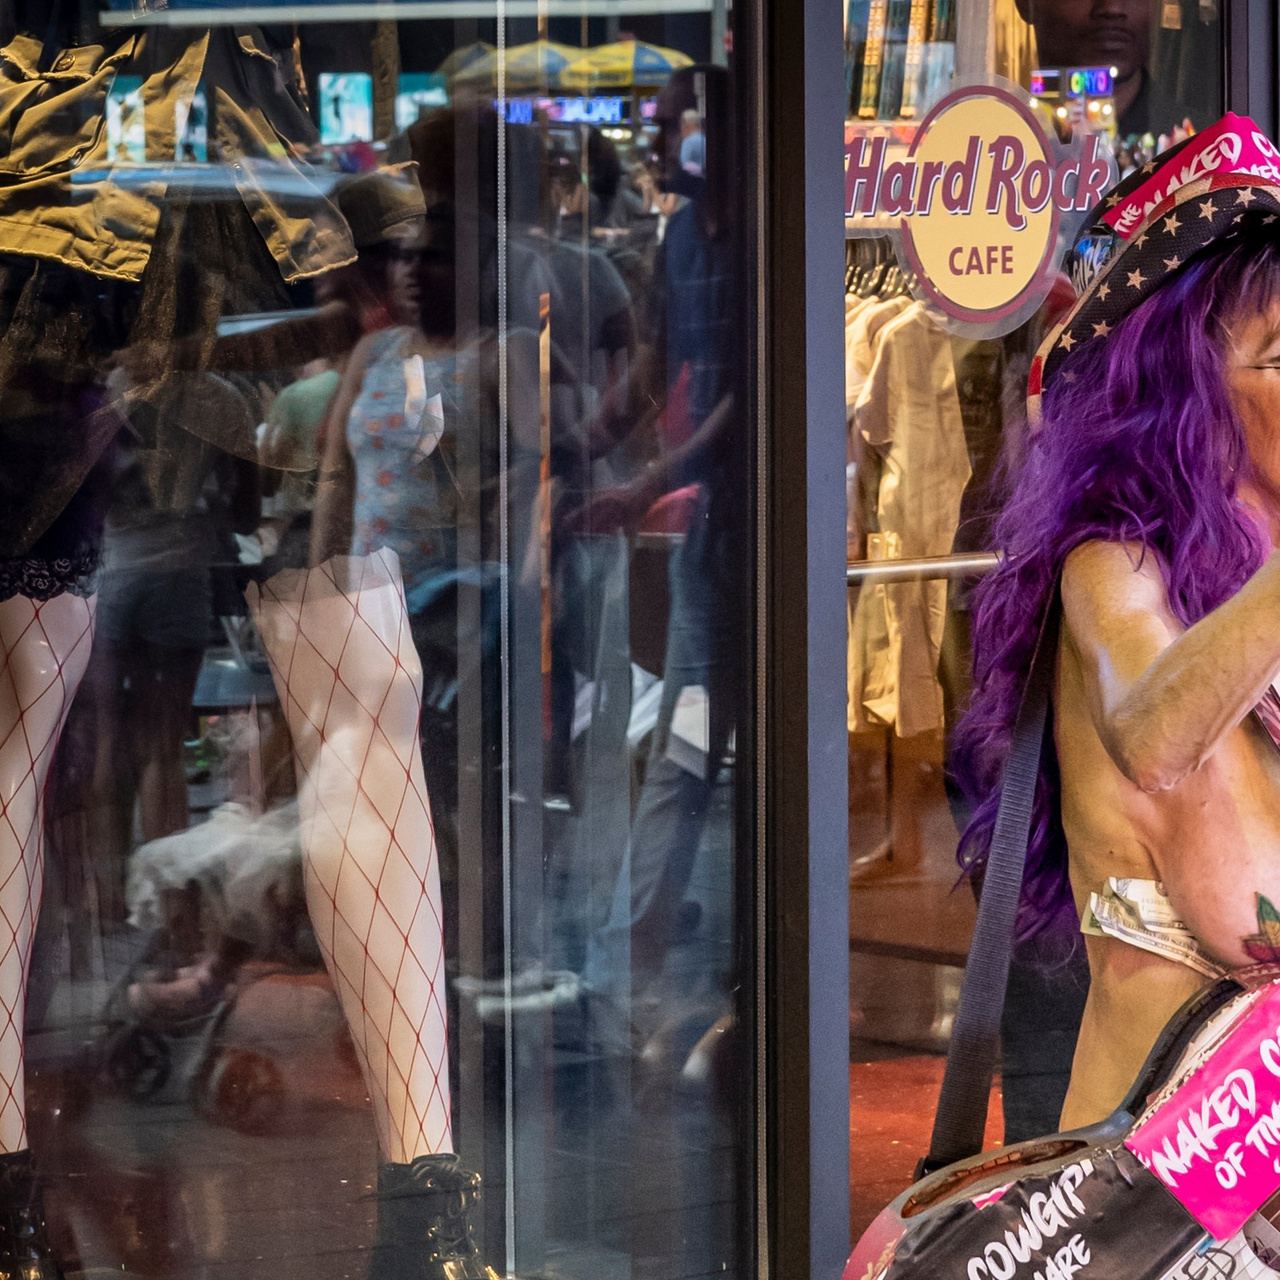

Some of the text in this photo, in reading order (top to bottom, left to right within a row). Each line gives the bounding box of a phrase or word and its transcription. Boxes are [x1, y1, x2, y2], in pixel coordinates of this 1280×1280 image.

[845, 135, 1110, 231] Hard Rock
[1114, 203, 1143, 234] THE
[948, 245, 1014, 276] CAFE
[1152, 1068, 1256, 1188] NAKED
[1214, 1142, 1246, 1190] OF
